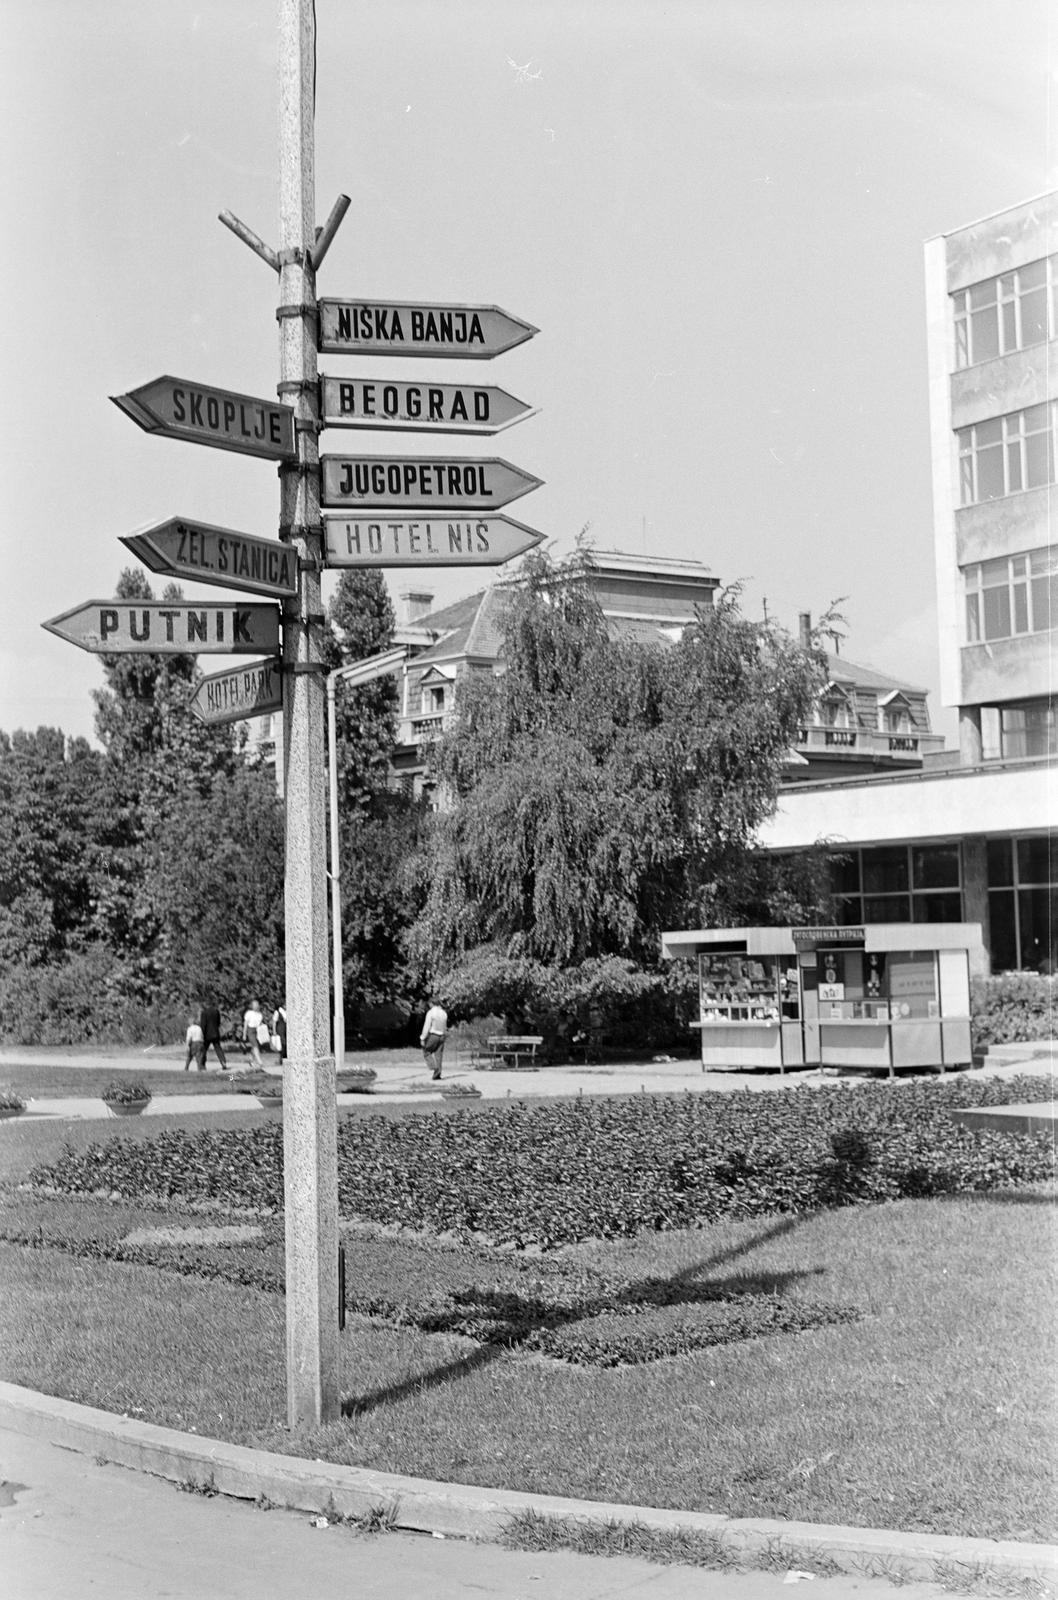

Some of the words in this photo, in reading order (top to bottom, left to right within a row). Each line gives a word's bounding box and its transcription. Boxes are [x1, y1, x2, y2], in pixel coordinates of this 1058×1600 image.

[338, 304, 404, 341] NIŠKA
[411, 310, 486, 344] BANJA
[172, 388, 282, 444] SKOPLJE
[339, 383, 490, 421] BEOGRAD
[339, 463, 493, 496] JUGOPETROL
[346, 523, 440, 554] HOTEL
[447, 519, 490, 553] NIŠ
[218, 537, 290, 586] STANICA
[100, 609, 254, 643] PUTNIK
[244, 665, 274, 704] PARK
